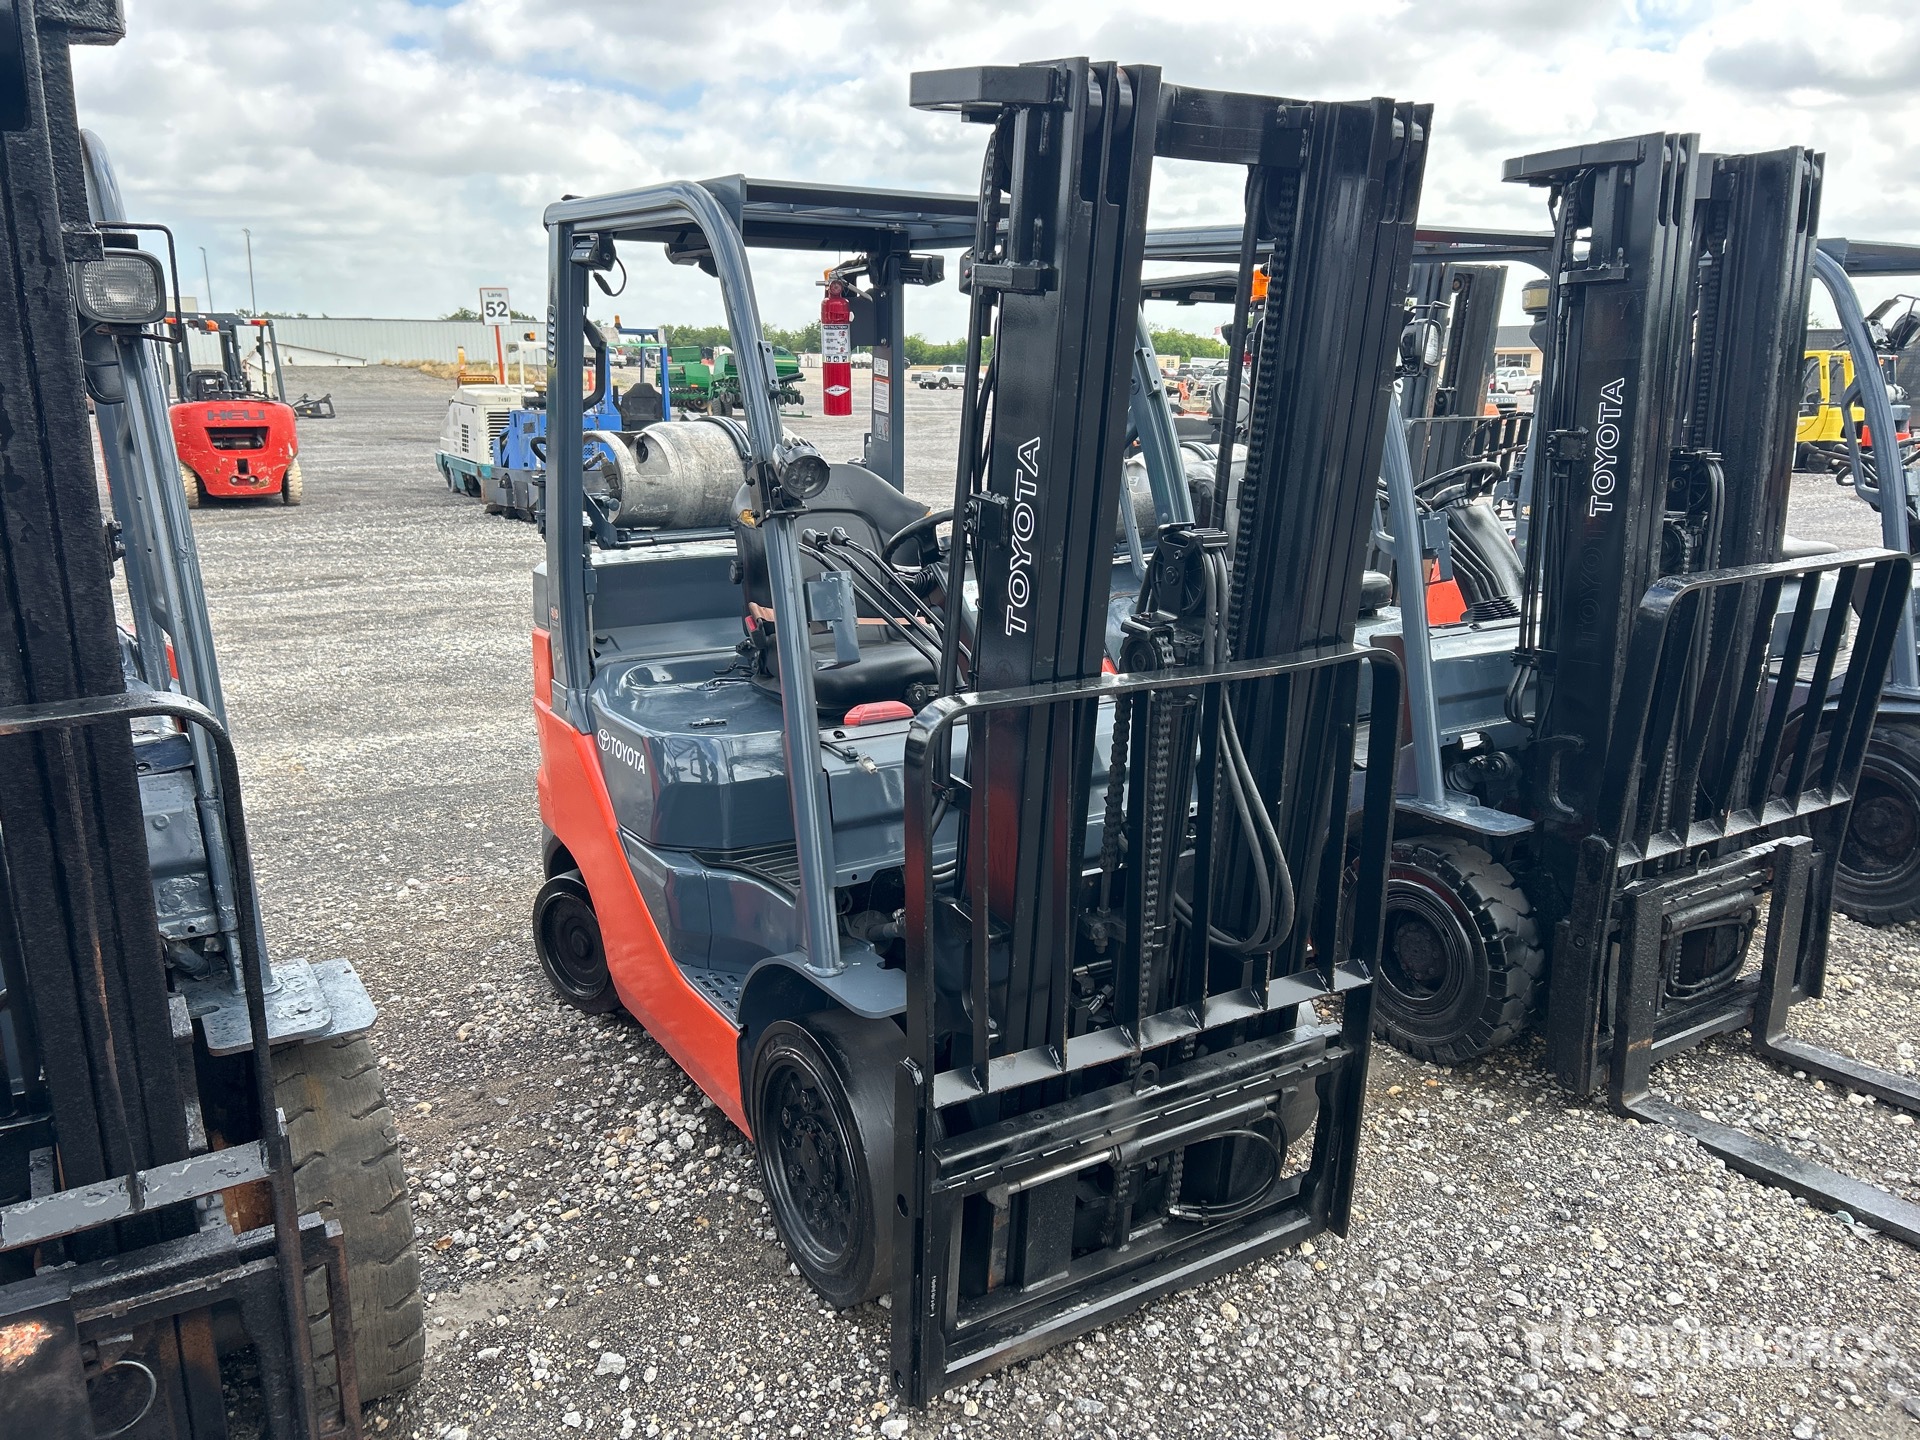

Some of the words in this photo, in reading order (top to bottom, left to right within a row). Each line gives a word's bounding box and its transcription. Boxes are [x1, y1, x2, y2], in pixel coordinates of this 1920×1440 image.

[485, 301, 508, 317] 52
[207, 410, 265, 421] HELI
[1589, 377, 1625, 517] TOYOTA
[1005, 436, 1041, 636] TOYOTA
[610, 735, 646, 775] TOYOTA
